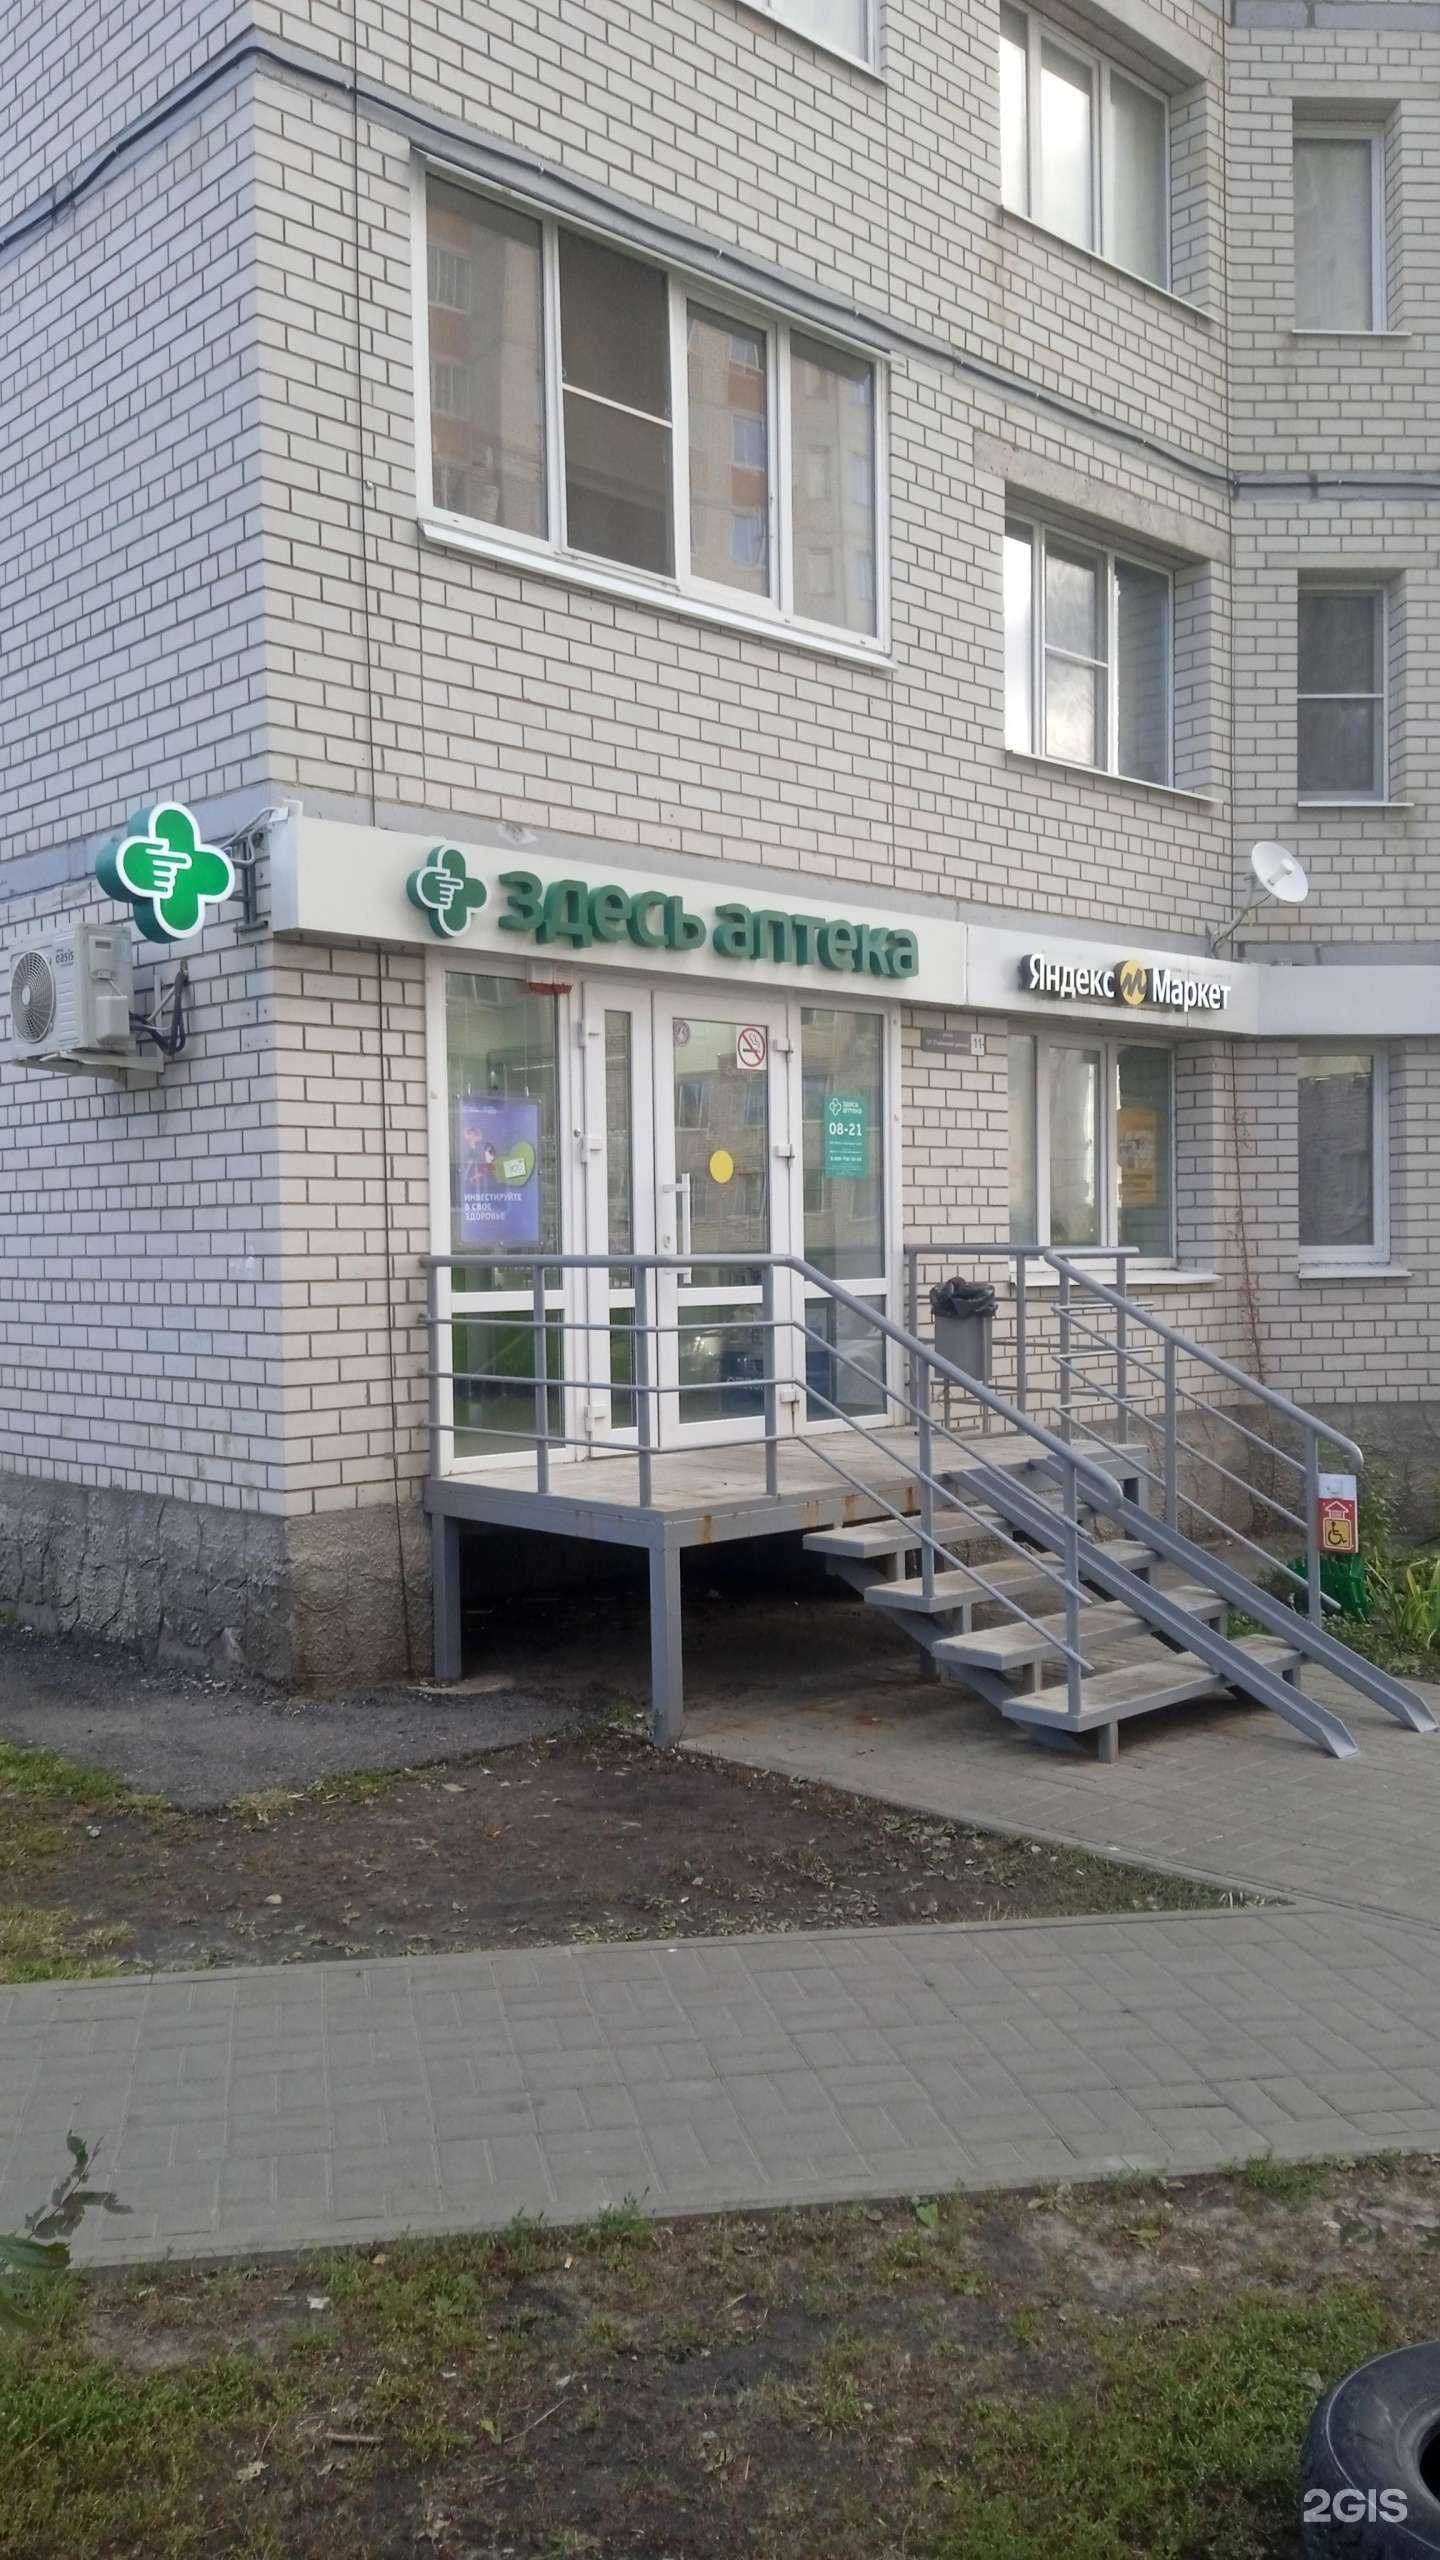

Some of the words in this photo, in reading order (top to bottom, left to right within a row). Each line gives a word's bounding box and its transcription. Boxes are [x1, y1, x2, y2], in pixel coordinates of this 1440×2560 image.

[714, 902, 919, 980] аптека
[1027, 952, 1115, 999] Яндекс
[1152, 970, 1231, 1013] Маркет
[829, 1122, 862, 1137] 08-21
